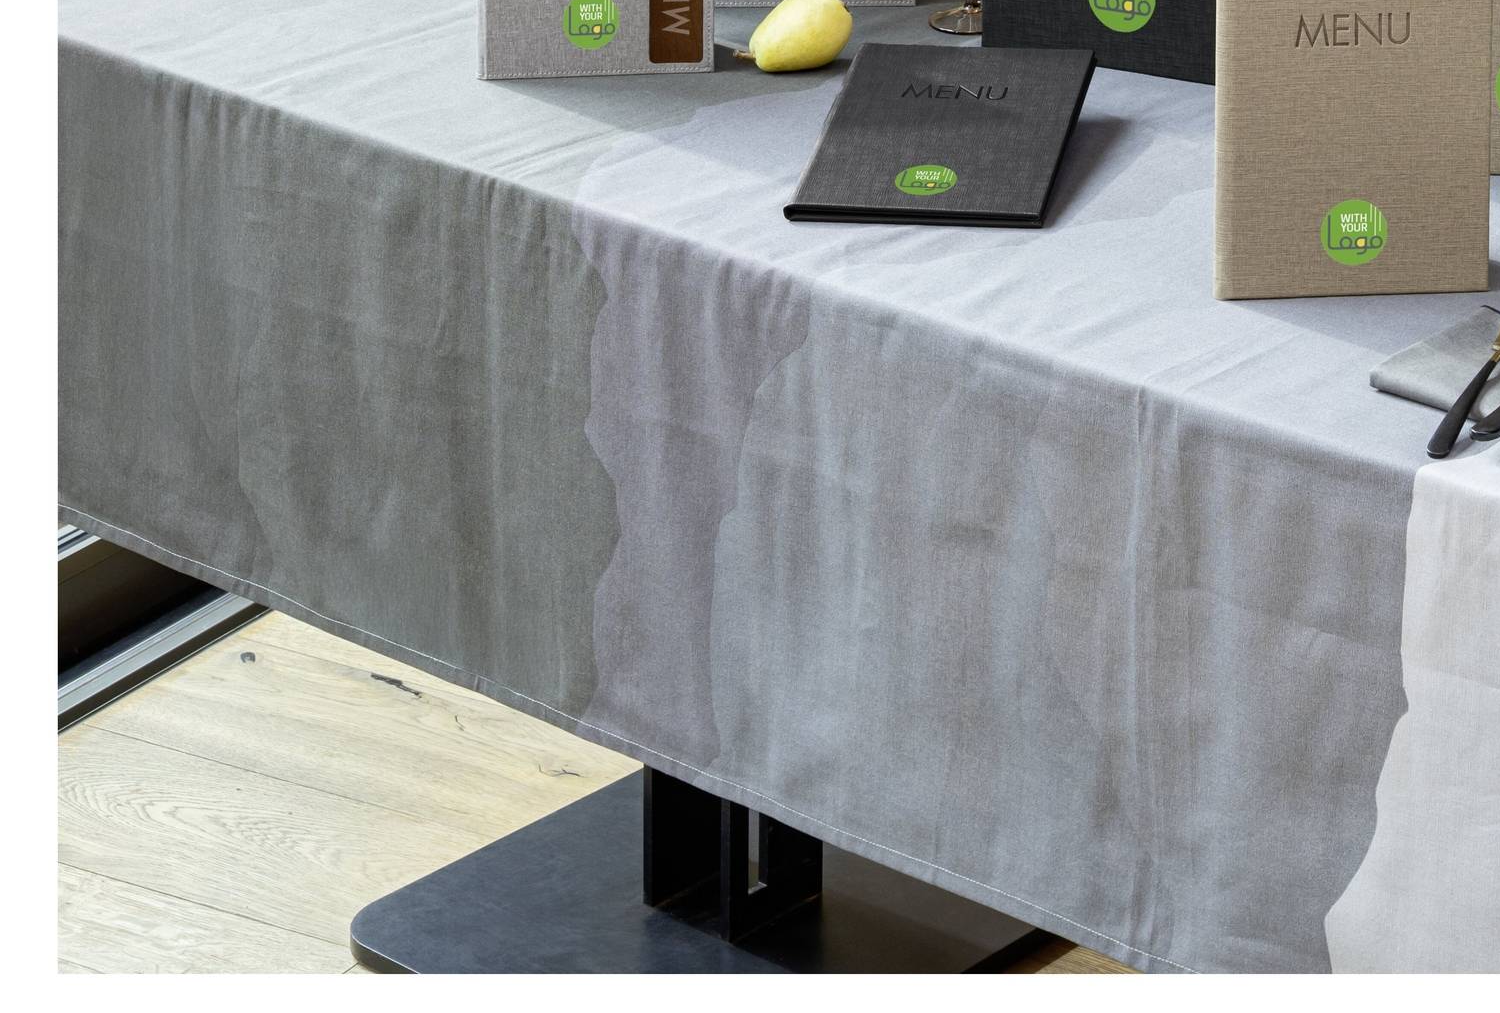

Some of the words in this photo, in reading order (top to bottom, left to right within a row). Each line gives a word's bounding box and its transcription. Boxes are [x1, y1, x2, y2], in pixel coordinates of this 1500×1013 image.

[579, 3, 603, 13] WITH
[579, 12, 603, 21] YOUR
[1294, 12, 1412, 48] MENU
[900, 81, 1010, 102] MENU
[1340, 213, 1368, 223] WITH
[1340, 222, 1368, 233] YOUR
